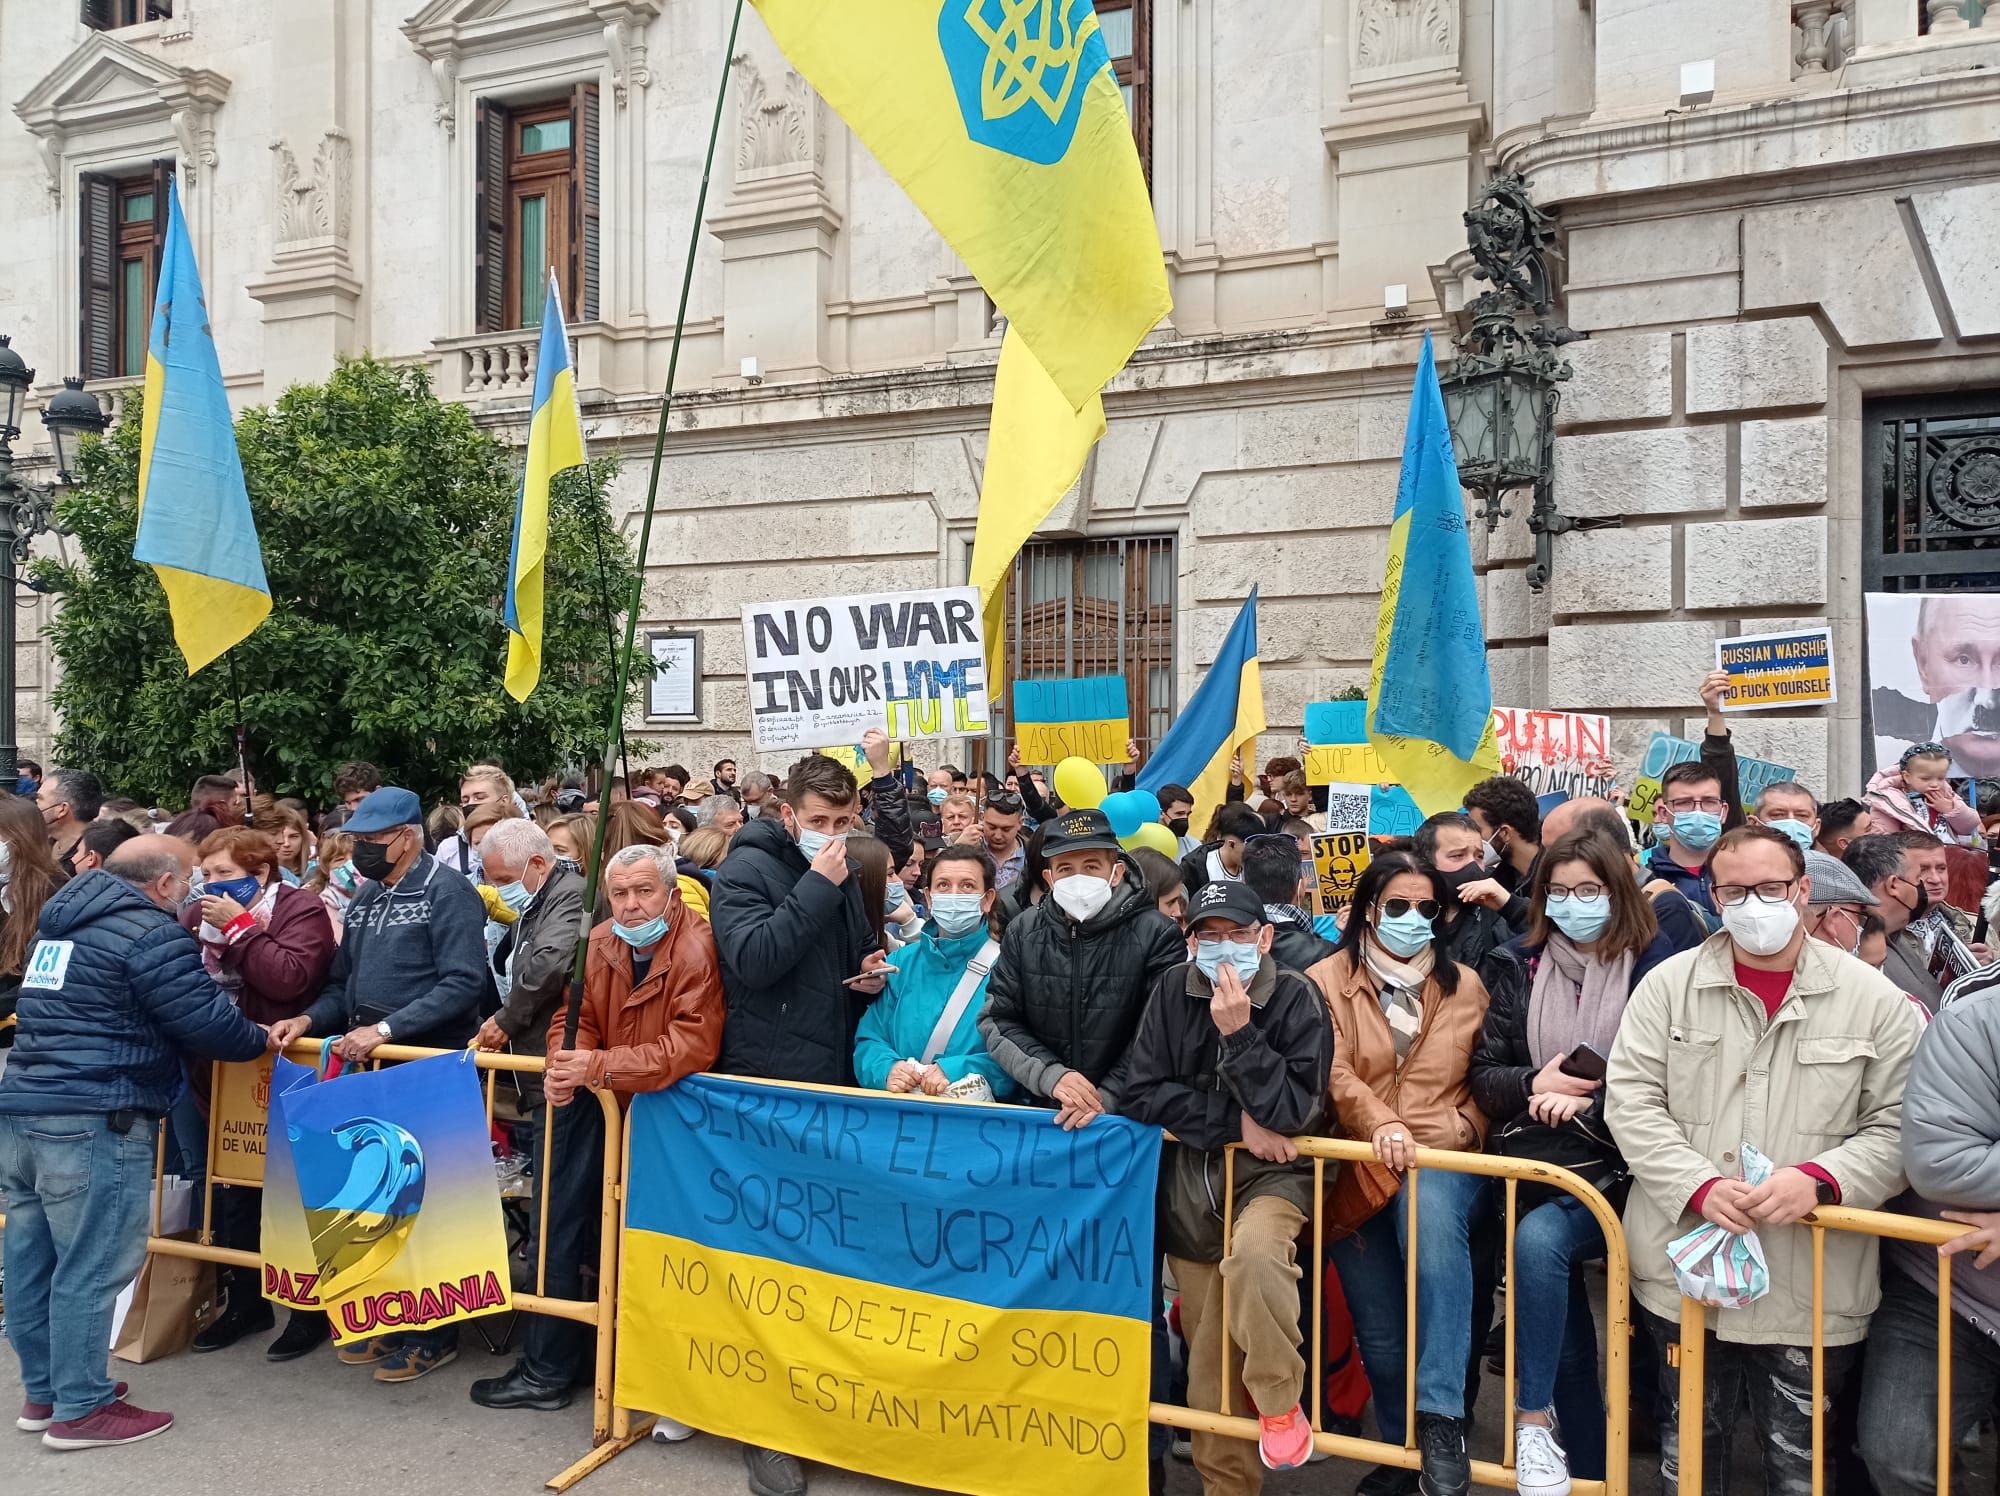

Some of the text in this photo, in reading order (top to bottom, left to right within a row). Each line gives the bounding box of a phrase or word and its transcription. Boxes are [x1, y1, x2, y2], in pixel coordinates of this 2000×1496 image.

[753, 599, 978, 658] NO WAR
[1722, 639, 1828, 665] RUSSIAN WARSHIP
[1766, 661, 1807, 679] нахуй
[752, 657, 987, 739] IN OUR HOME
[1031, 678, 1112, 720] PUTIN
[1741, 682, 1770, 698] FUCK
[1772, 677, 1831, 696] YOURSELF
[1028, 723, 1114, 764] ASESINO
[1493, 708, 1606, 761] PUTIN
[1310, 747, 1352, 776] STOP
[1060, 815, 1092, 828] ATALAYA
[1312, 835, 1367, 858] STOP
[1207, 897, 1226, 905] PAULI
[223, 1138, 239, 1152] DE
[889, 1110, 950, 1181] EL
[966, 1117, 1137, 1189] SIELO
[703, 1167, 1143, 1288] SOBRE UCRANIA
[265, 1263, 321, 1305] PAZ
[342, 1270, 506, 1333] UCRANIA
[661, 1254, 1121, 1378] NO NOS DEJEIS SOLO
[688, 1338, 1127, 1461] NOS ESTAN MATANDO
